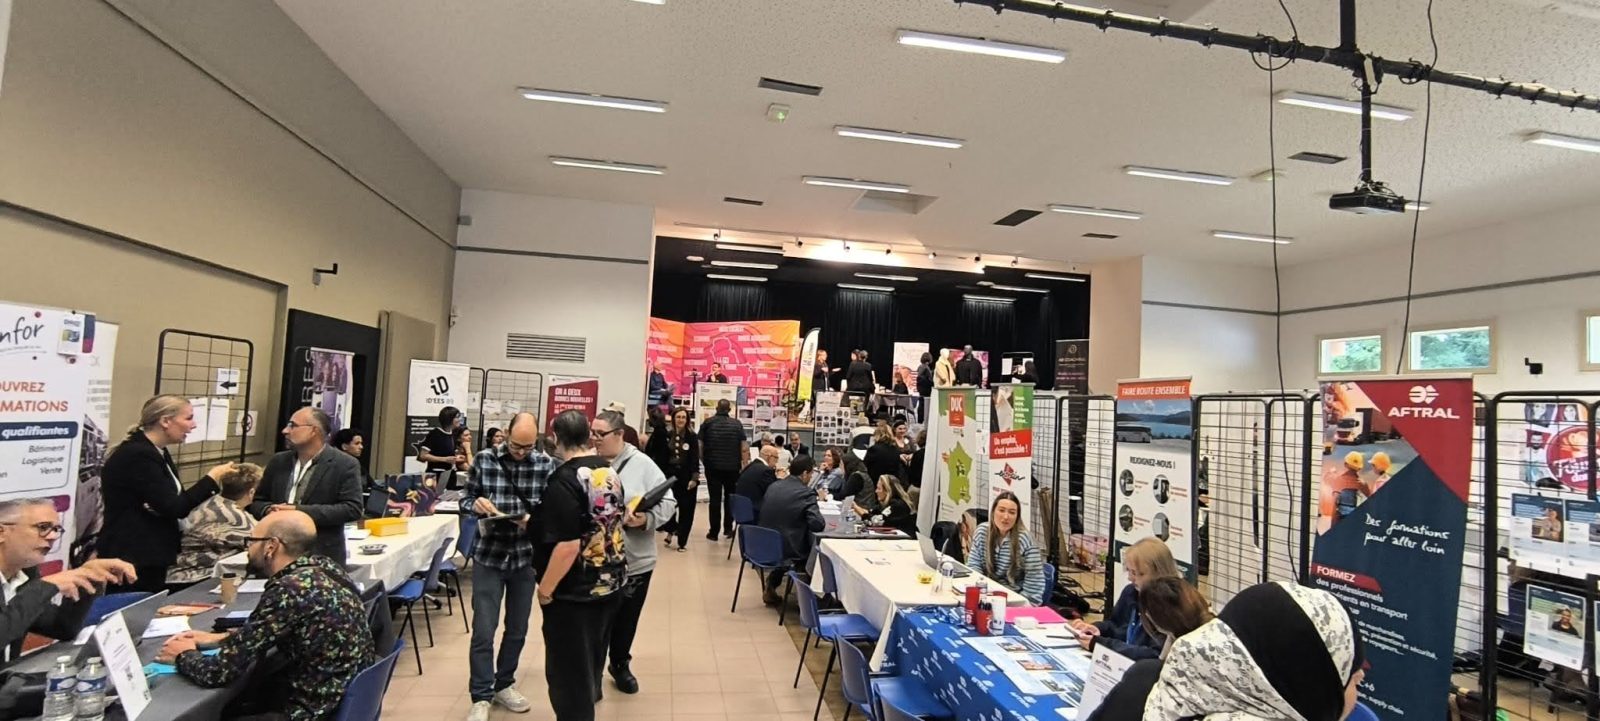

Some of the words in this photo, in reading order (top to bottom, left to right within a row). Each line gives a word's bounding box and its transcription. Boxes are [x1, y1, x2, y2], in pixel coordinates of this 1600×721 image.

[0, 381, 45, 393] UVREZ
[1121, 387, 1136, 396] FAIRE
[1136, 386, 1154, 395] ROUTE
[1154, 385, 1186, 395] ENSEMBLE
[950, 396, 963, 412] DUC
[1387, 406, 1460, 419] AFTRAL
[1, 425, 69, 440] qualifiantes
[1005, 444, 1025, 456] possible
[22, 457, 64, 466] Logistique
[1129, 456, 1172, 469] REJOIGNEZ-NOUS
[1364, 513, 1381, 526] Des
[1386, 520, 1450, 540] formations
[1363, 532, 1387, 546] pour
[1391, 536, 1417, 549] aller
[1421, 540, 1445, 555] loin
[1316, 565, 1356, 583] FORMEZ
[1315, 578, 1329, 587] des
[1330, 582, 1384, 604] professionnels
[1359, 600, 1370, 609] en
[1370, 602, 1408, 621] transport
[1368, 696, 1388, 709] supply
[1387, 704, 1405, 716] chain
